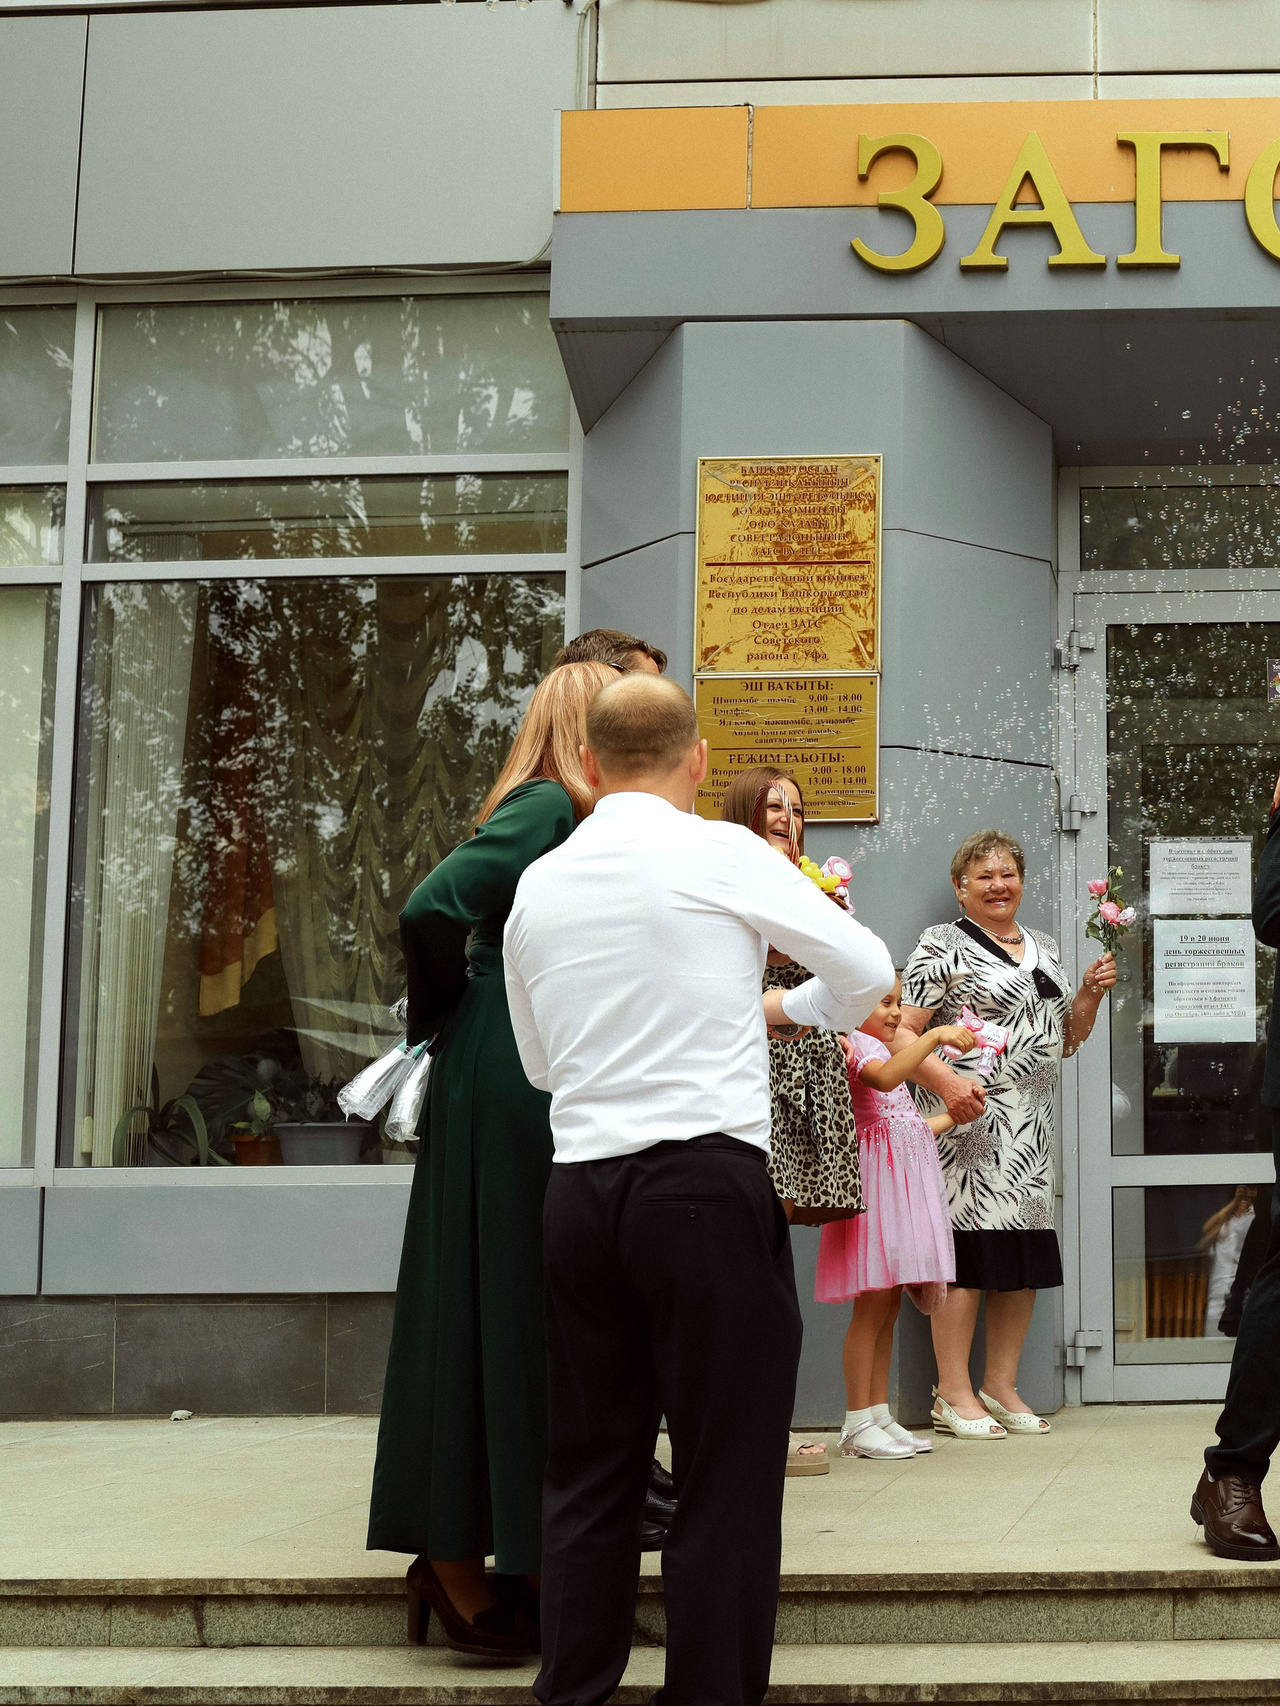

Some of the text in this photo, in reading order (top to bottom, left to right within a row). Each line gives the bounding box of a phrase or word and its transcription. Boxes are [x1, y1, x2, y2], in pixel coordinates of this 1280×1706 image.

[741, 465, 838, 475] БАШКОРТОСТАН
[730, 533, 768, 543] СОВЕТ
[752, 547, 781, 556] ЗАГС
[709, 573, 867, 585] Государственный комитет
[708, 588, 868, 600] Республики Башкортостан
[751, 606, 786, 615] делам
[788, 605, 843, 615] юстиции
[752, 619, 824, 630] Отдел ЗАГС
[754, 635, 821, 645] Советского
[746, 650, 790, 663] района
[803, 650, 828, 662] Уфа
[741, 681, 763, 691] ЭШ
[808, 693, 829, 703] 9.00
[838, 693, 862, 703] 18.00
[803, 705, 829, 714] 13.00
[838, 705, 863, 714] 14.00
[729, 752, 845, 764] РЕЖИМ РАБОТЫ:
[711, 767, 744, 777] Вторни
[812, 766, 832, 775] 9.00
[841, 765, 866, 774] 18.00
[808, 776, 833, 786] 13.00
[843, 776, 867, 785] 14.00
[1197, 934, 1207, 942] 20
[1184, 948, 1245, 957] торжественных
[1165, 960, 1245, 969] регистраций браков
